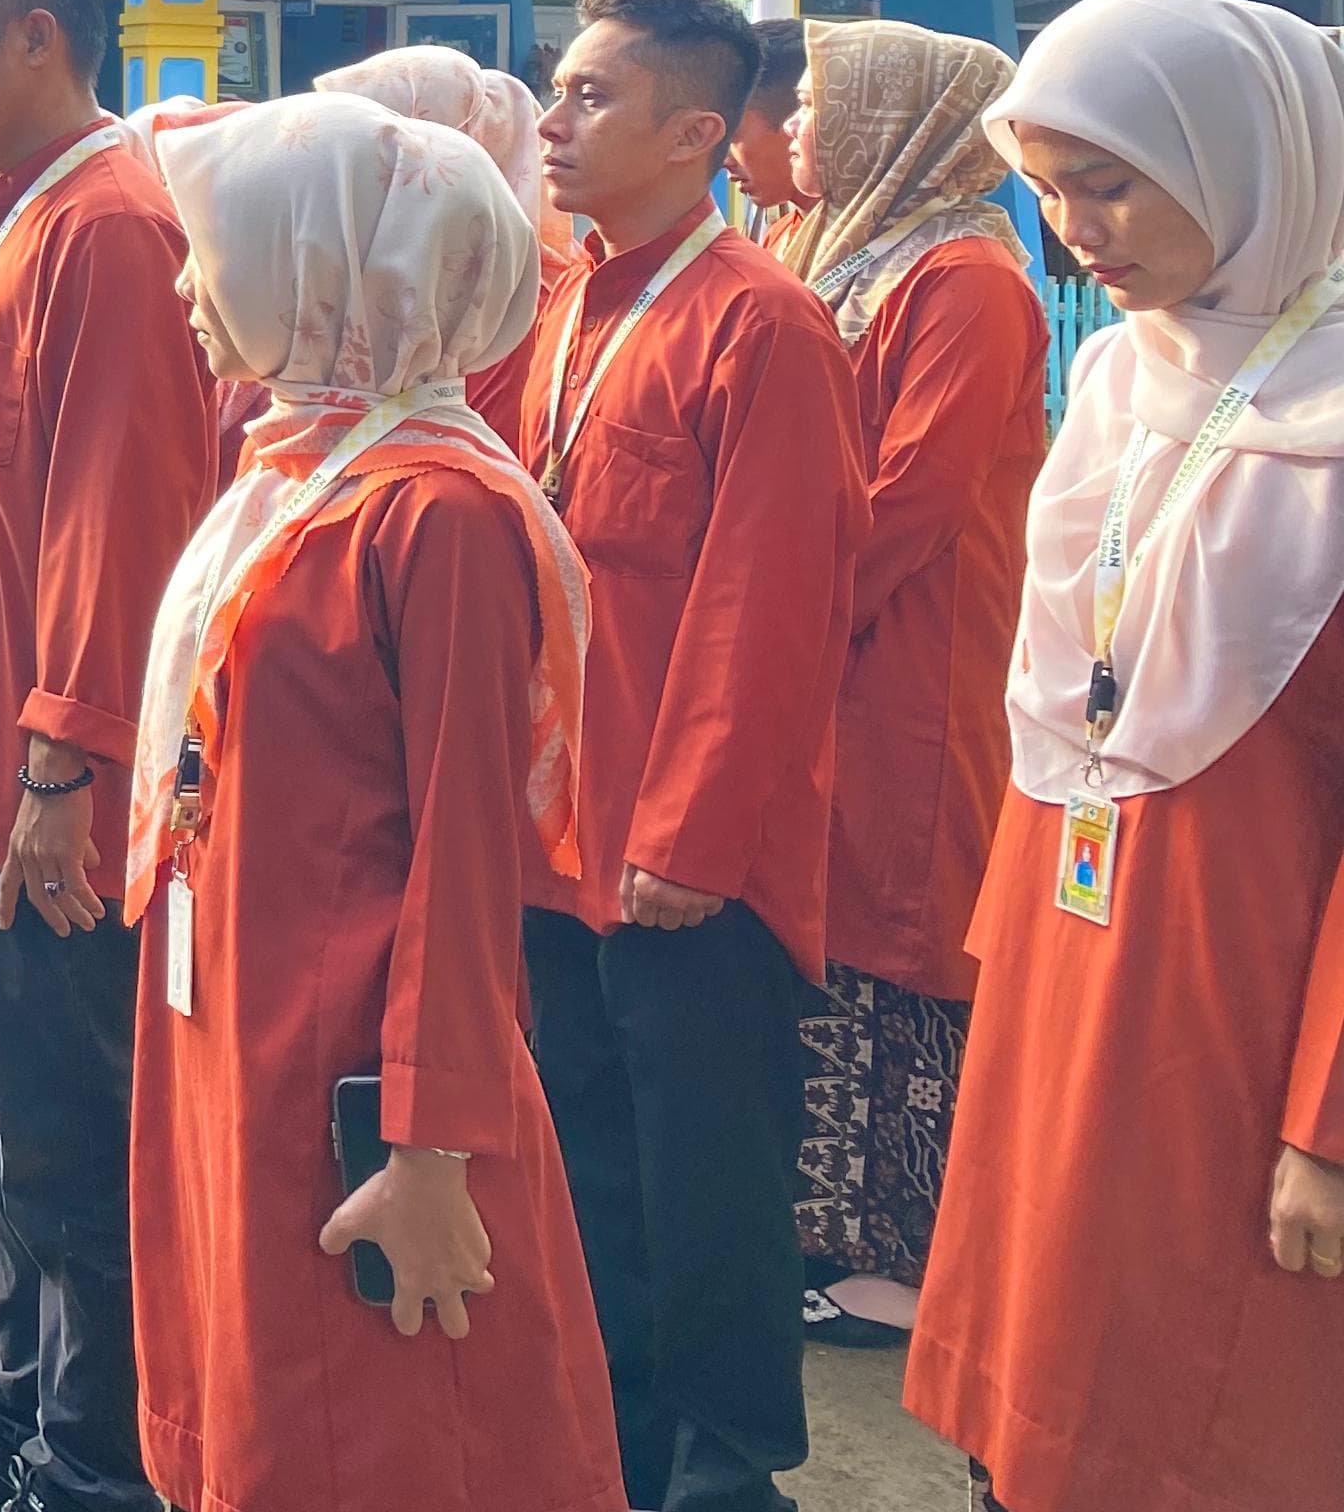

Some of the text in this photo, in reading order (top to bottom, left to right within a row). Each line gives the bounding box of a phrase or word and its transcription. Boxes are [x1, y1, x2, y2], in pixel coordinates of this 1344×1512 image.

[1206, 386, 1240, 431] TAPAN
[1223, 391, 1250, 424] TAPAN
[287, 472, 322, 512] TAPAN
[1108, 520, 1122, 568] TAPAN
